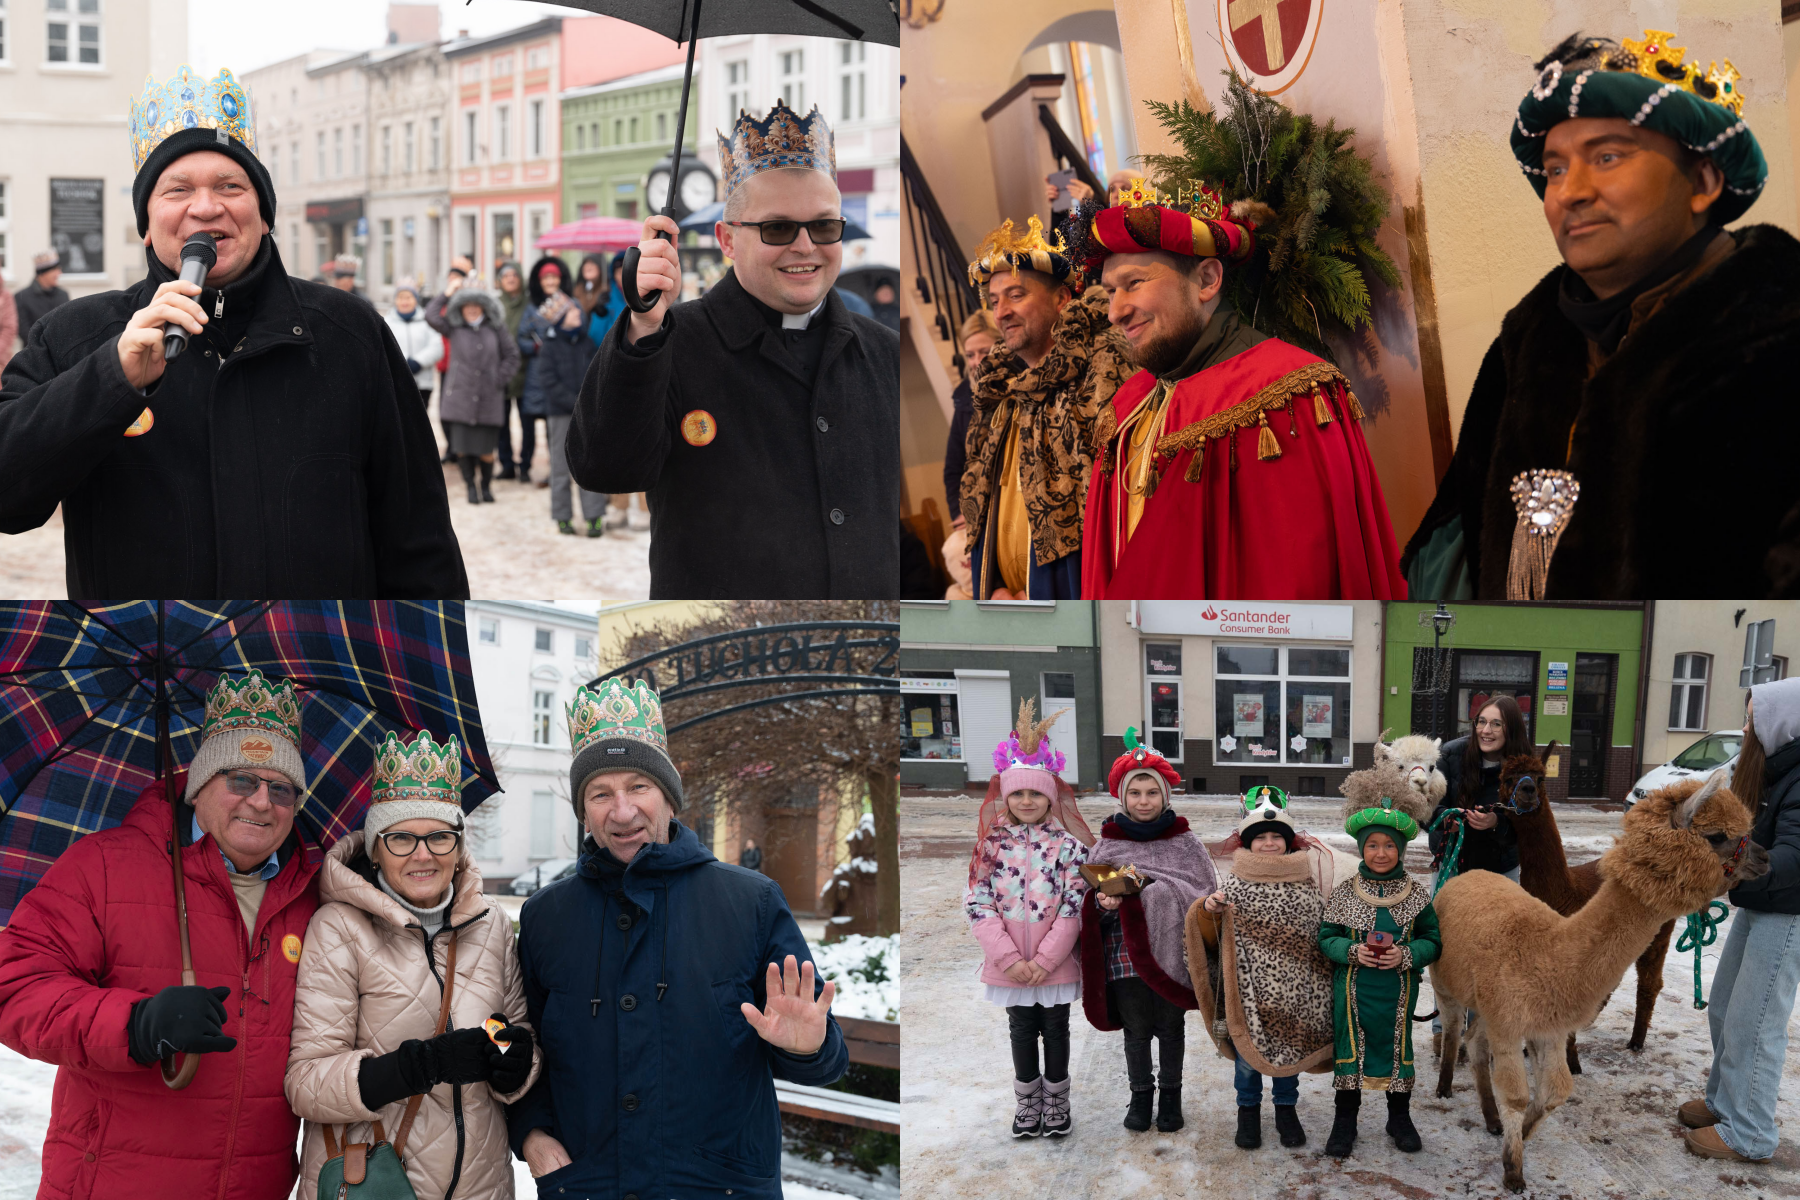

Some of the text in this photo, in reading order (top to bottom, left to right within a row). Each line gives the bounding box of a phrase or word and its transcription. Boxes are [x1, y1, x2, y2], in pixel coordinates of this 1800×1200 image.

[1220, 609, 1291, 624] Santander
[1220, 624, 1291, 635] Consumer Bank
[667, 632, 852, 690] TUCHOLA
